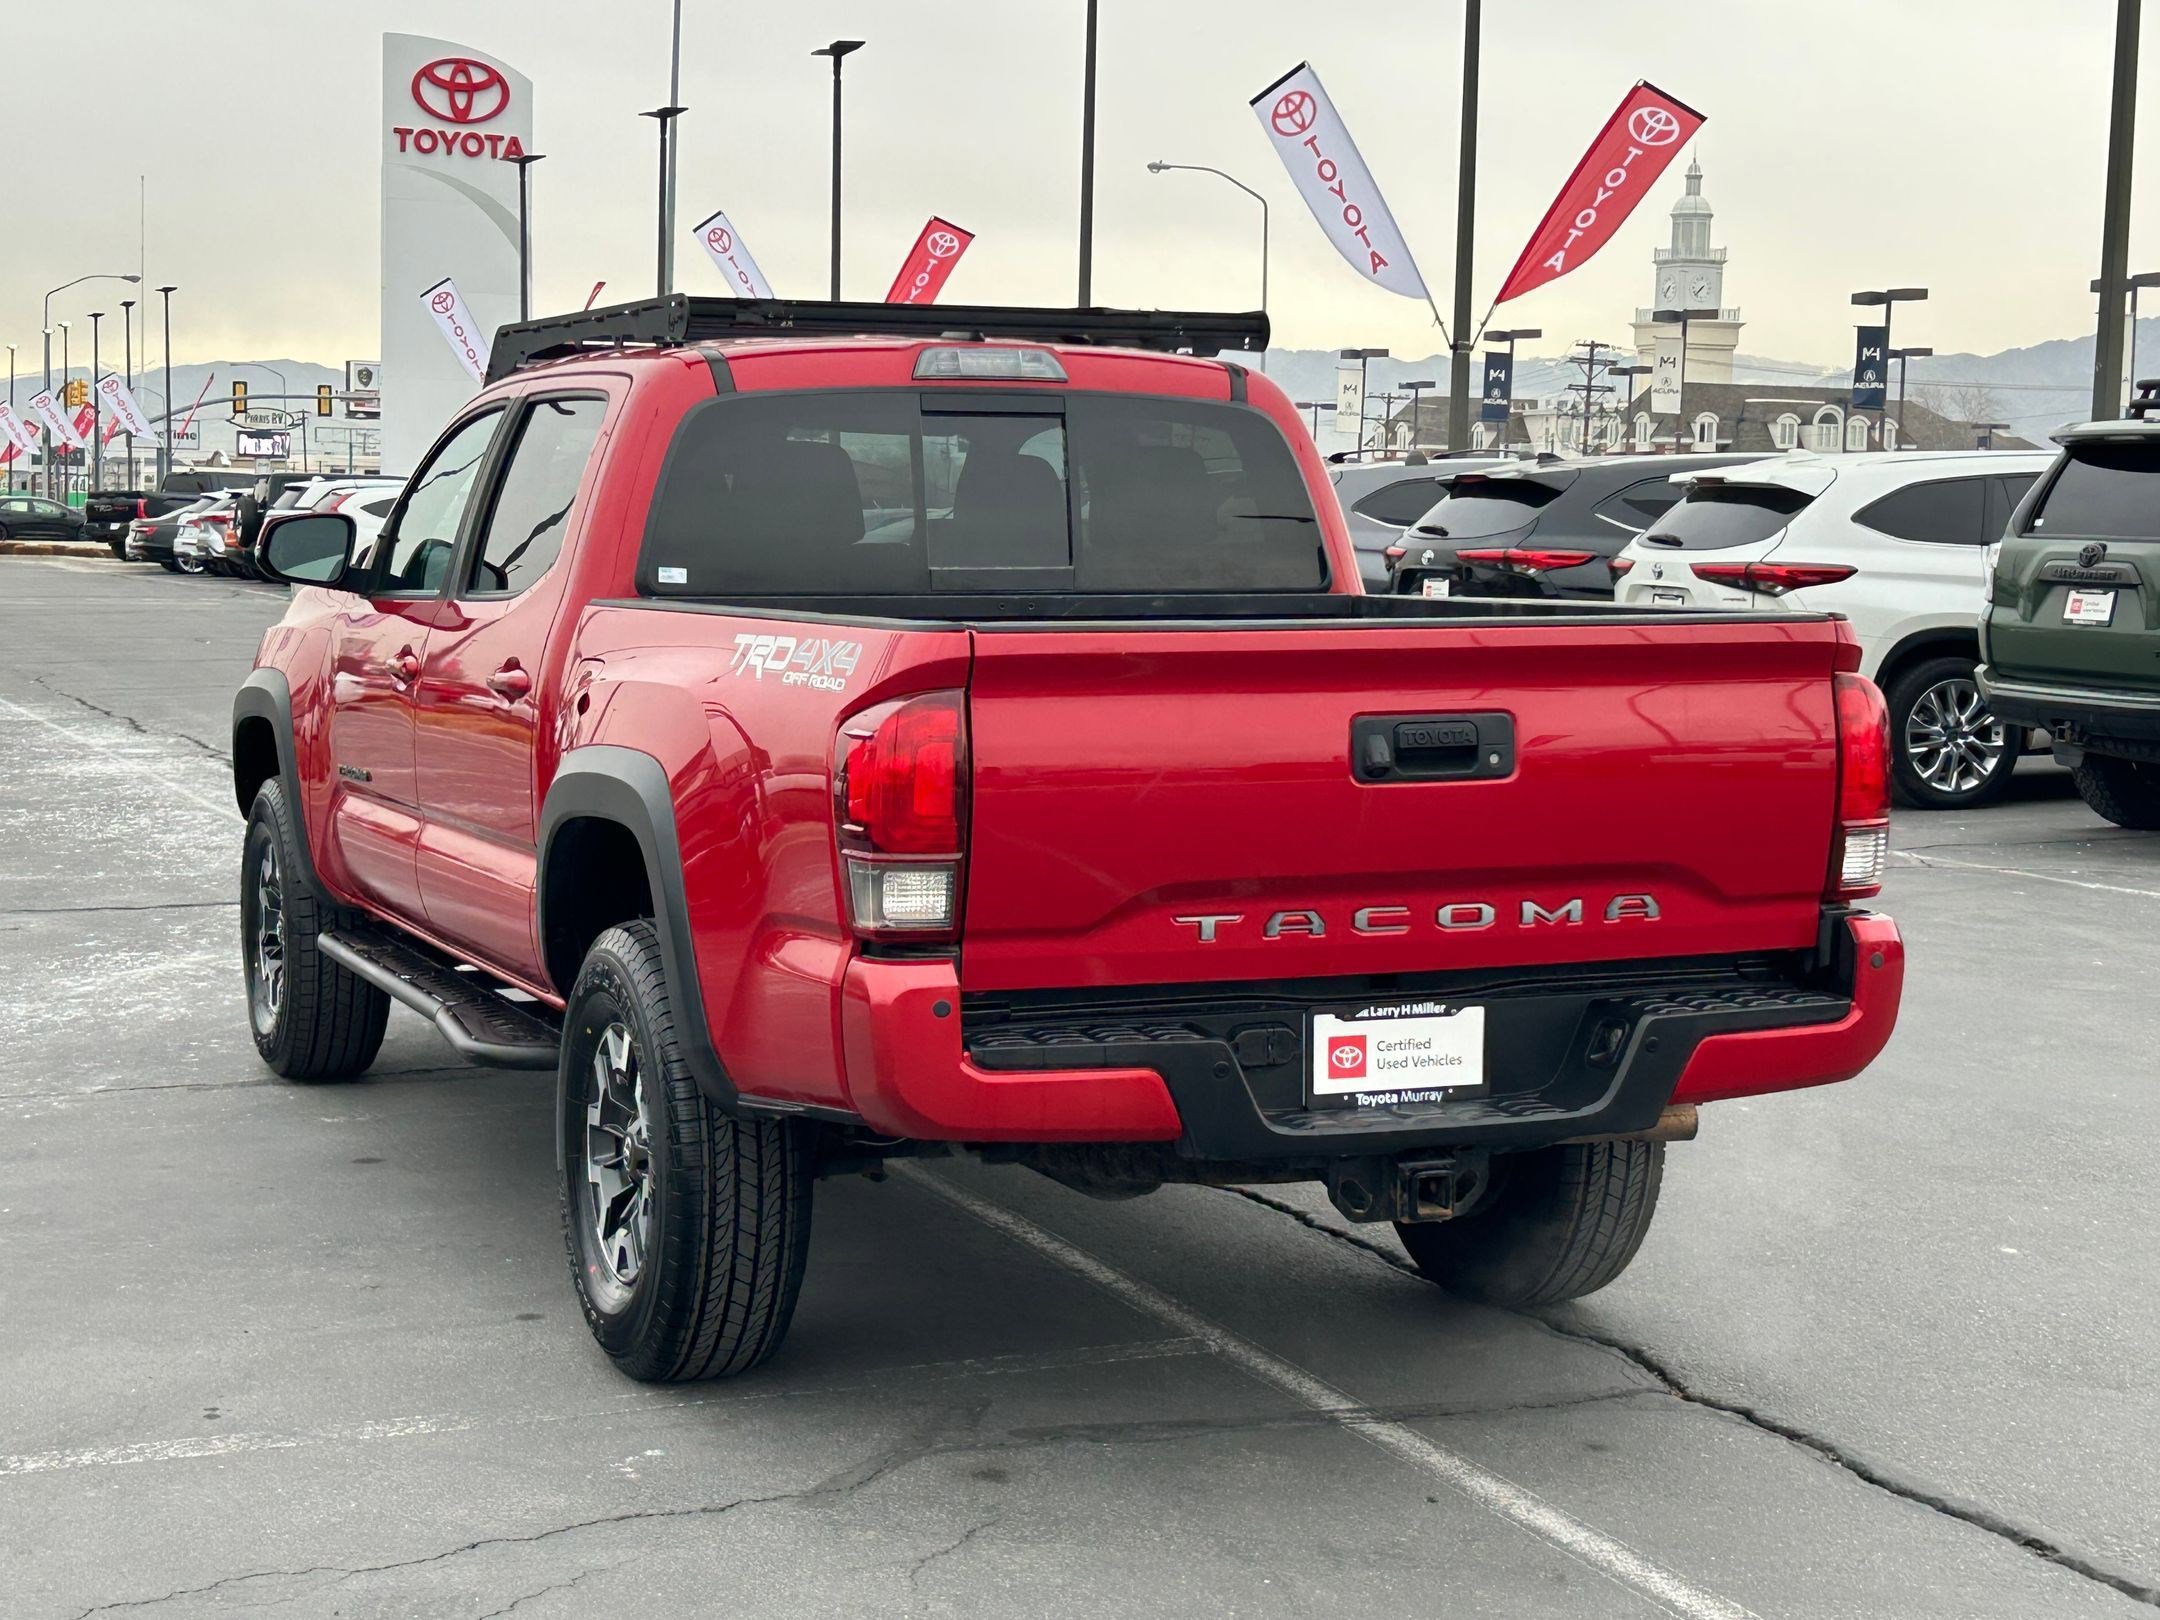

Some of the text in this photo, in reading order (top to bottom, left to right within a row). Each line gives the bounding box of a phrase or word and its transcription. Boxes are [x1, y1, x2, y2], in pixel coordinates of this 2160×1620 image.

[393, 127, 525, 160] TOYOTA
[1303, 134, 1389, 275] TOYOTA
[1542, 145, 1644, 273] TOYOTA
[727, 254, 758, 299] TOY
[903, 258, 939, 304] TOY
[1853, 381, 1885, 390] ACURA
[112, 392, 143, 435] TOYOTA
[730, 633, 797, 681] TRD
[782, 671, 846, 692] OFF ROAD
[1404, 727, 1474, 746] TOYOTA
[1171, 894, 1661, 944] TACOMA
[1370, 1002, 1447, 1018] Larry H Miller
[1376, 1038, 1432, 1052] Certified
[1376, 1054, 1463, 1070] Used Vehicles
[1355, 1090, 1444, 1107] Toyota Murray
